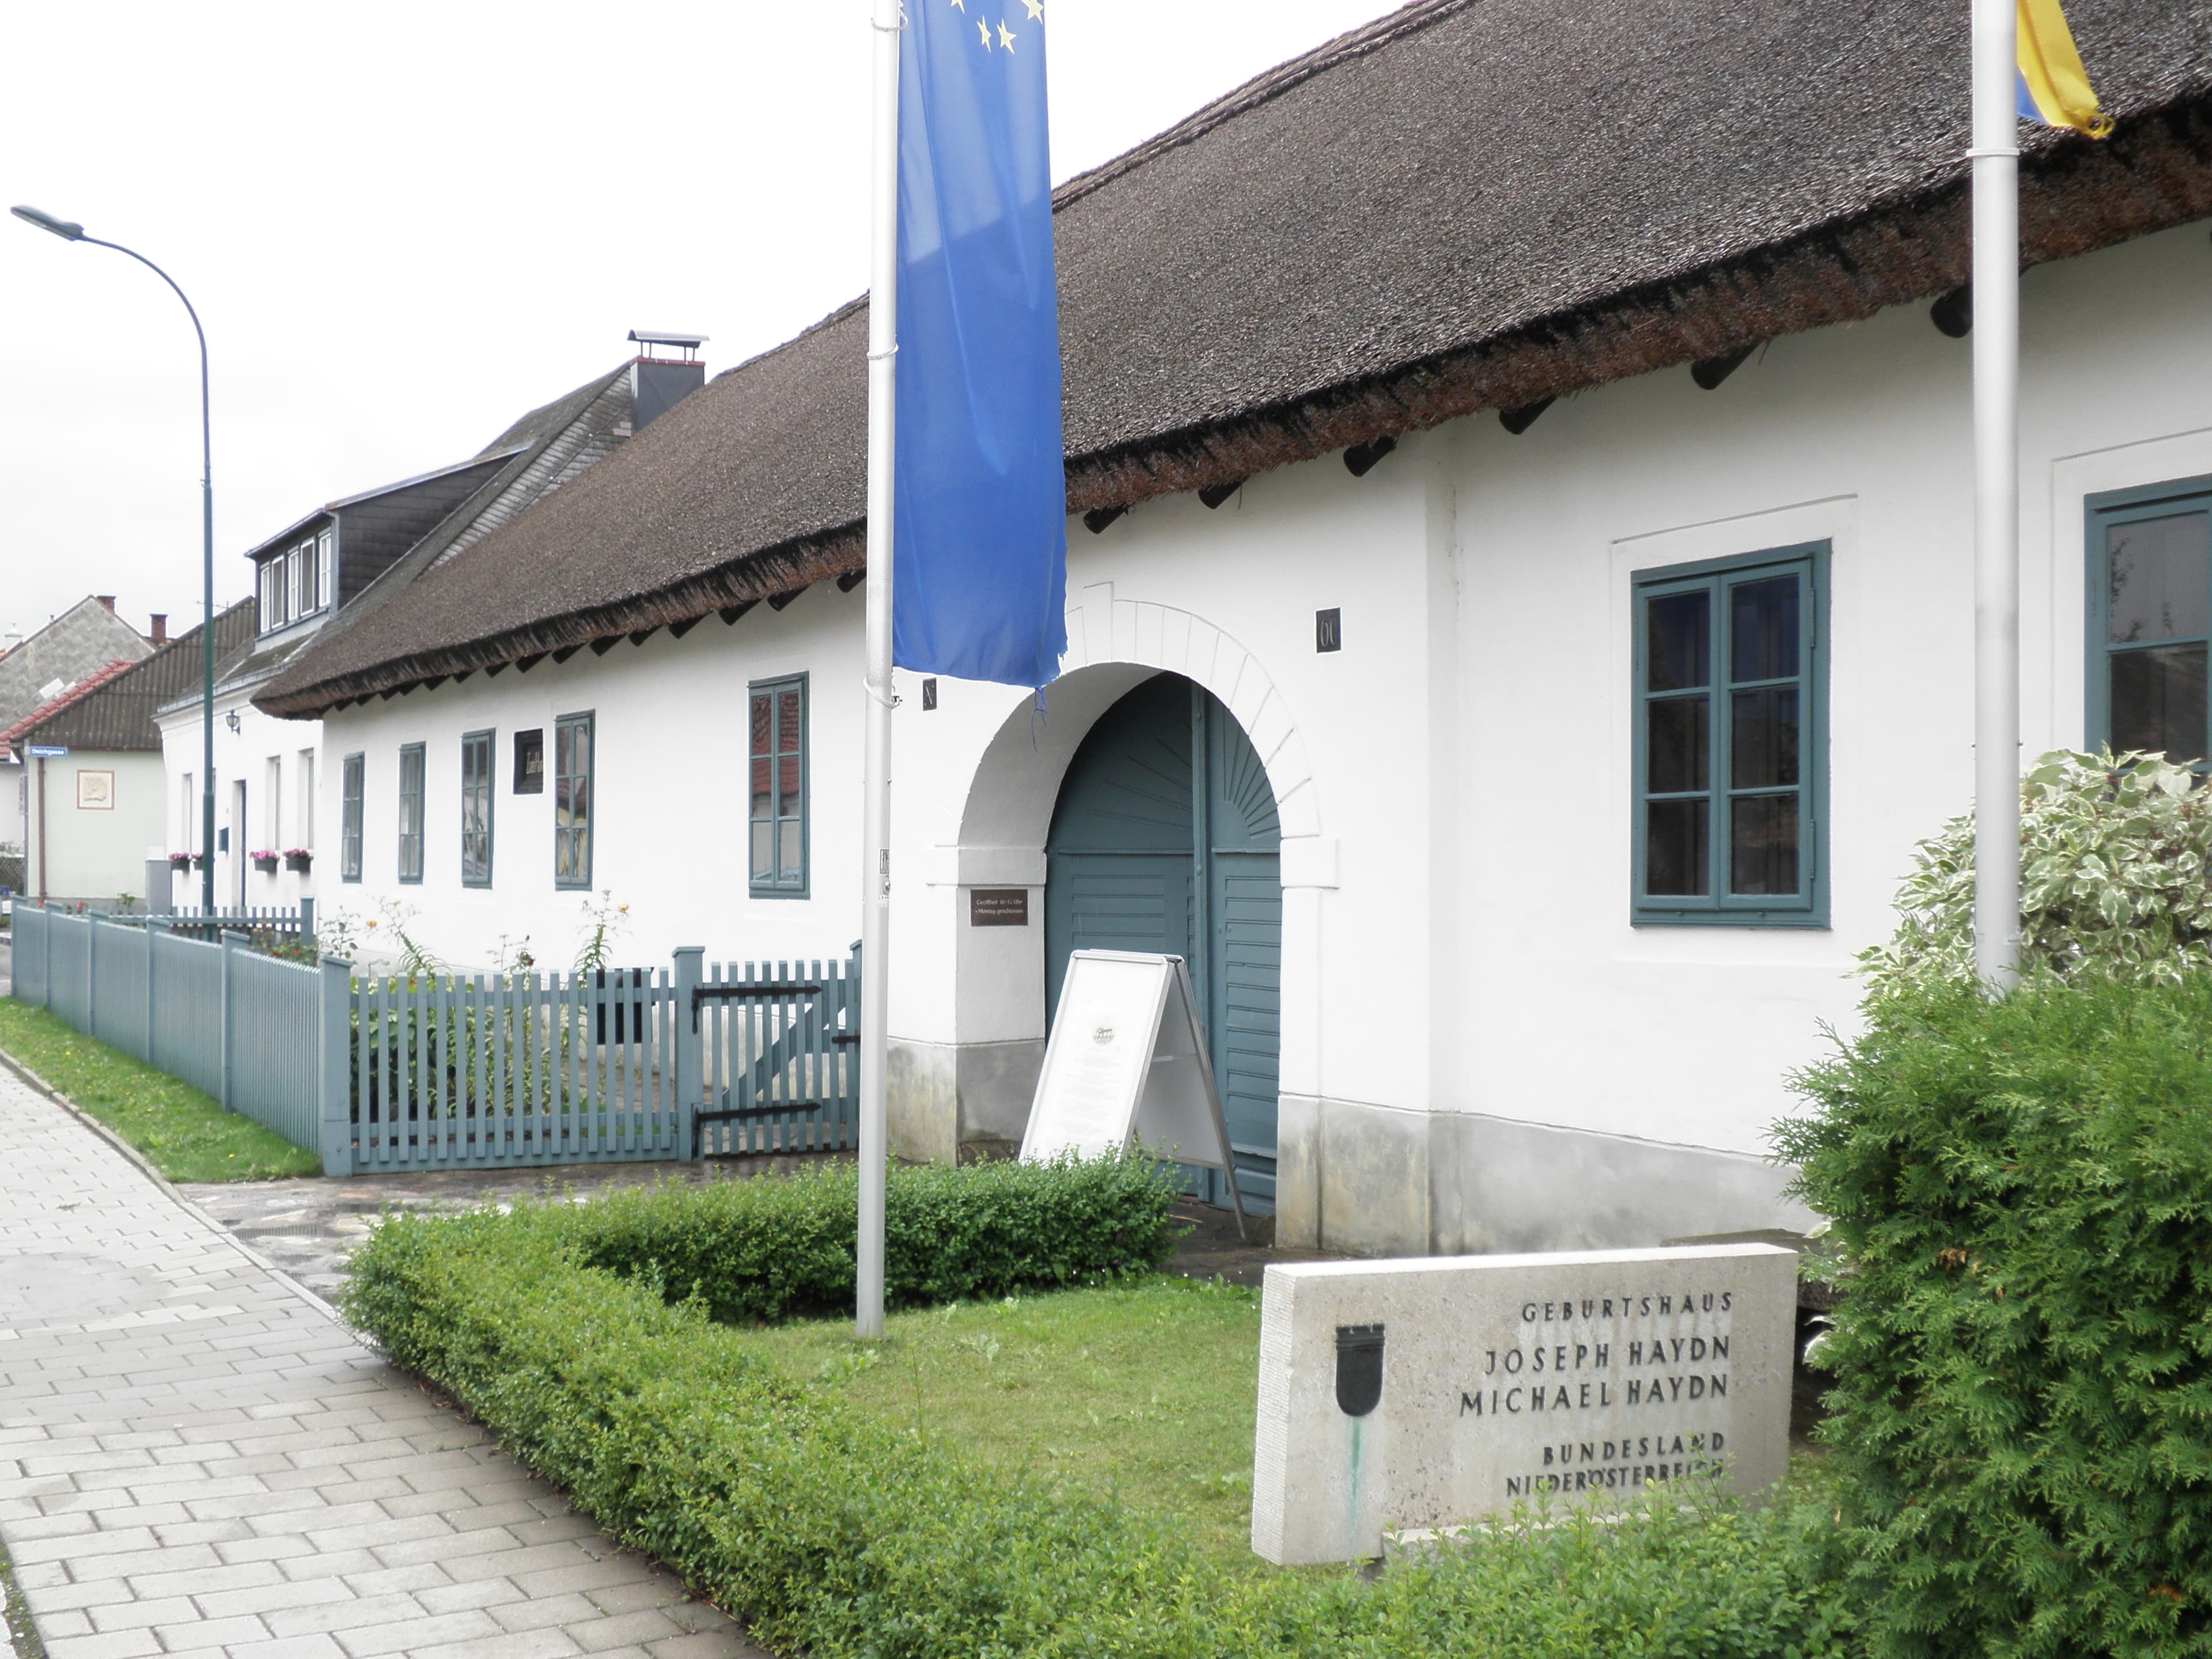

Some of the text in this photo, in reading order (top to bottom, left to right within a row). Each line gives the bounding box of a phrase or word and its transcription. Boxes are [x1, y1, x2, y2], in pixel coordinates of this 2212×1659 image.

[1522, 1292, 1732, 1323] GEBURTSHAUS
[1485, 1335, 1730, 1376] JOSEPH HAYDN
[1460, 1374, 1728, 1417] MICHAEL HAYDN
[1543, 1432, 1725, 1466] BUNDESLAND
